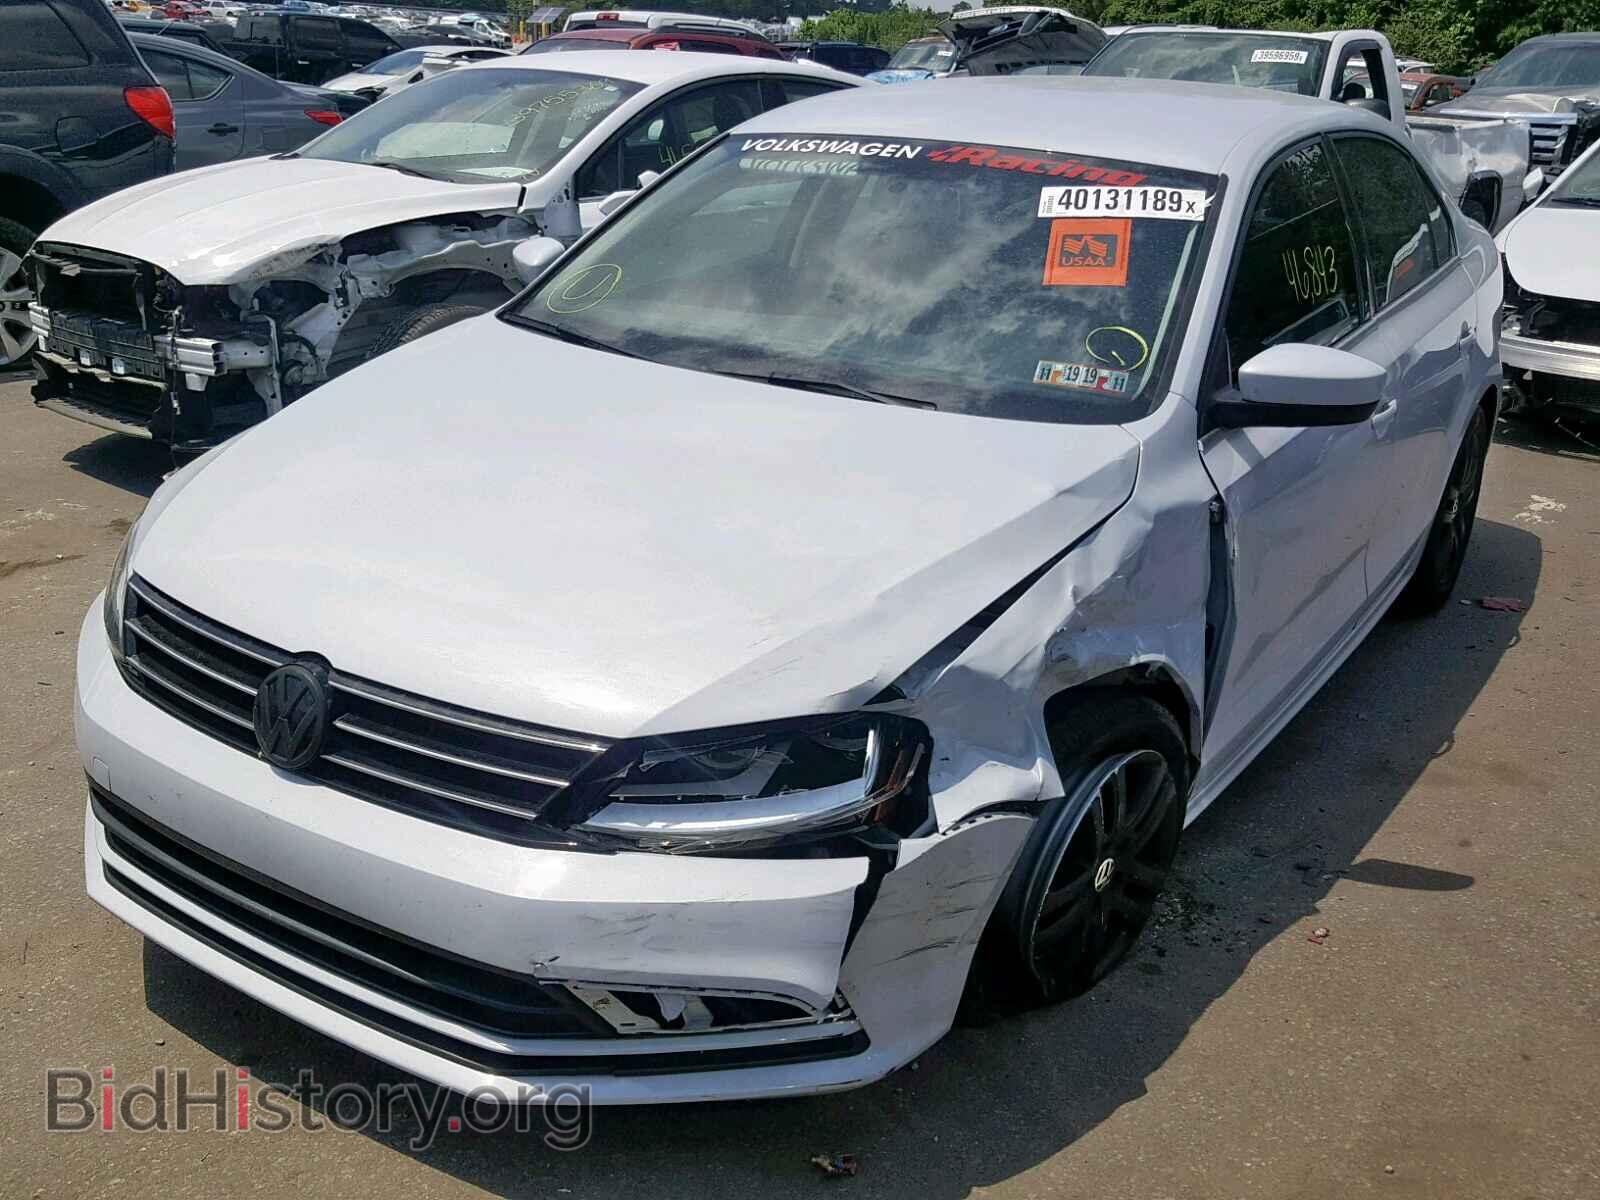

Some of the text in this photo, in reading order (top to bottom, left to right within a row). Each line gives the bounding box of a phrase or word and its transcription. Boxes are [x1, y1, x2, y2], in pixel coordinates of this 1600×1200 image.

[740, 138, 922, 159] VOLKSWAGEN
[1061, 256, 1106, 266] USAA
[1281, 244, 1338, 305] 46,843
[1064, 366, 1080, 382] 19
[1083, 367, 1098, 384] 19
